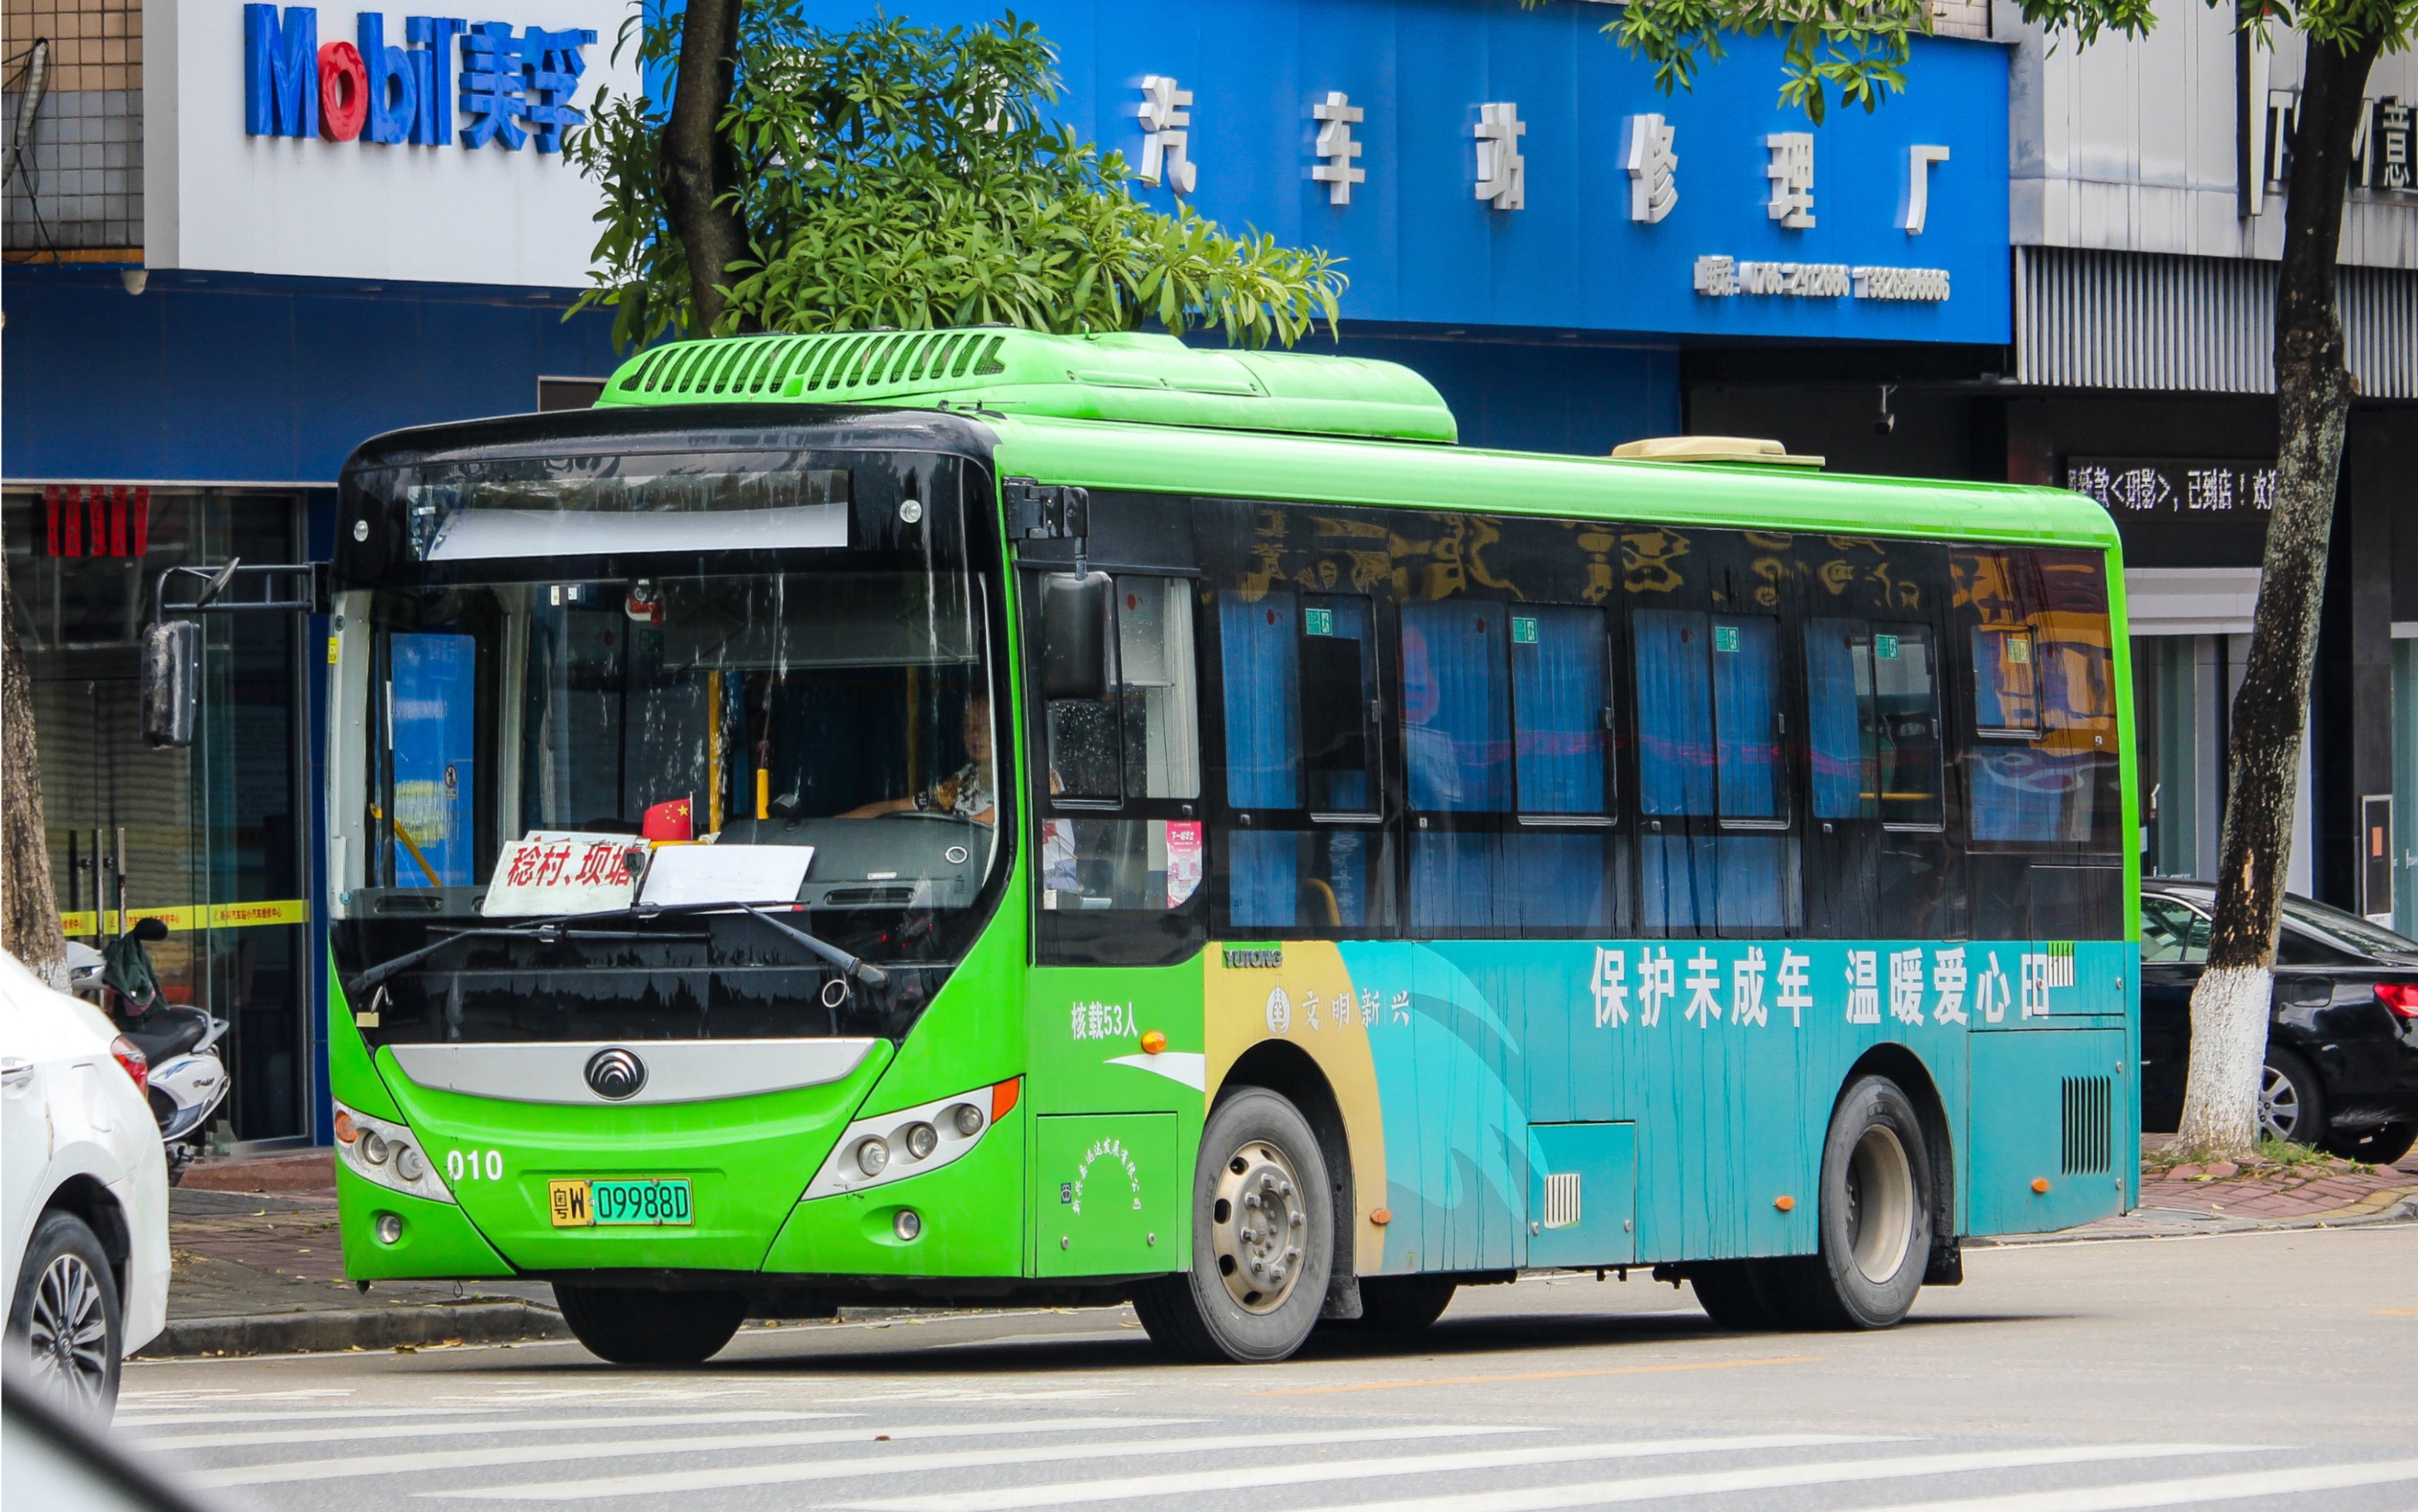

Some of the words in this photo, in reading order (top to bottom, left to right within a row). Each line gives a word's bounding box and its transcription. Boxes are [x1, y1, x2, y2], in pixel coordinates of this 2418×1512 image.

[245, 3, 453, 146] Mobil
[459, 21, 587, 154] 美孚
[1224, 949, 1283, 969] YUTONG
[1590, 947, 1814, 1029] 保护未成年
[1846, 947, 2051, 1027] 温暖爱心田
[1071, 1001, 1139, 1041] 核载53人
[1302, 987, 1410, 1033] 文明新兴
[447, 1150, 504, 1182] 010
[553, 1187, 586, 1220] 粤W
[597, 1186, 690, 1220] 09988D
